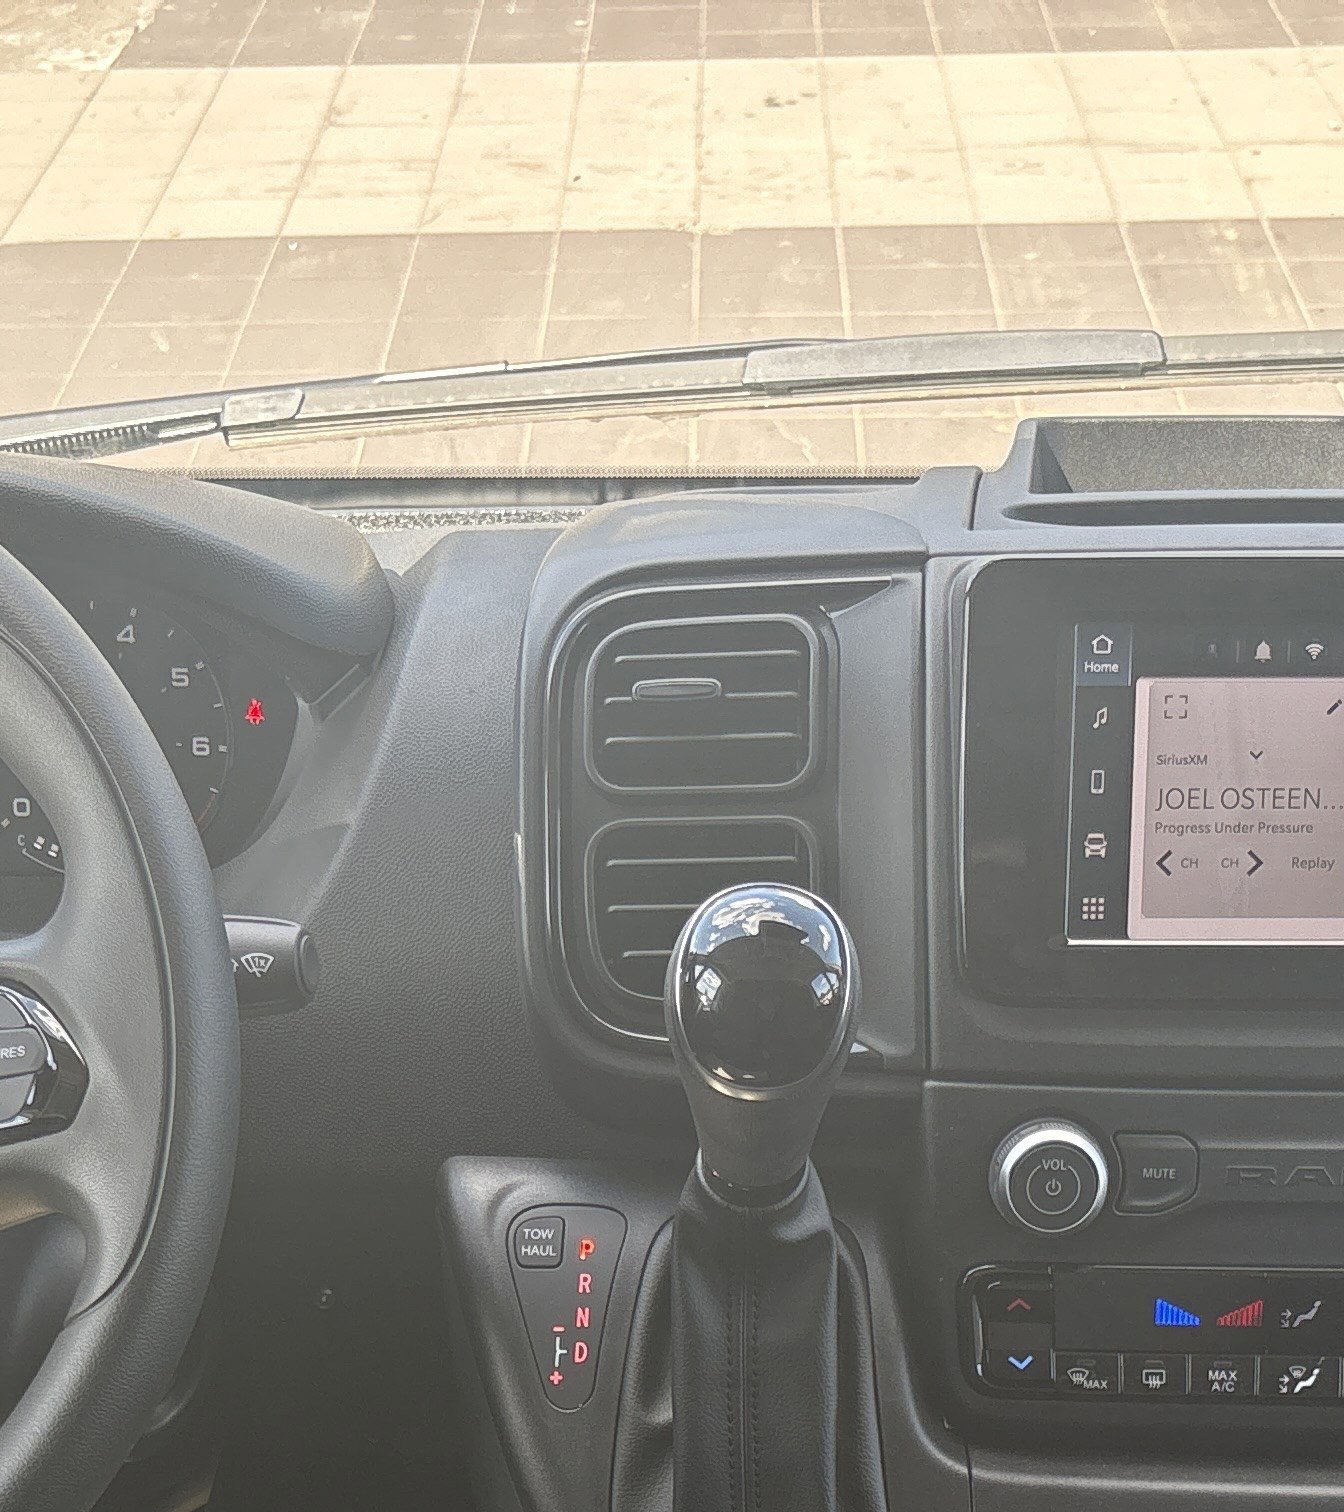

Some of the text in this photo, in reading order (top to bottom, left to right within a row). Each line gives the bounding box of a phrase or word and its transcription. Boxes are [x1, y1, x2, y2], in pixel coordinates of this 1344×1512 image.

[116, 625, 136, 645] 4
[1084, 661, 1119, 673] Home
[170, 666, 190, 688] 5
[191, 736, 211, 757] 6
[1156, 754, 1208, 766] SiriusXM
[1155, 786, 1344, 812] JOEL OSTEEN...
[12, 797, 31, 817] 0
[1154, 822, 1314, 836] Progress Under Pressure
[1180, 857, 1199, 869] CH
[1220, 857, 1239, 869] CH
[1291, 856, 1336, 872] Replay
[0, 1046, 26, 1059] RES
[1041, 1158, 1068, 1171] VOL
[1142, 1168, 1177, 1180] MUTE
[523, 1228, 555, 1240] TOW
[521, 1245, 557, 1257] HAUL
[578, 1239, 595, 1261] P
[578, 1273, 592, 1294] R
[575, 1307, 590, 1328] N
[573, 1341, 589, 1364] D
[1207, 1370, 1238, 1382] MAX
[1084, 1378, 1108, 1389] MAX
[1210, 1381, 1236, 1394] A/C
